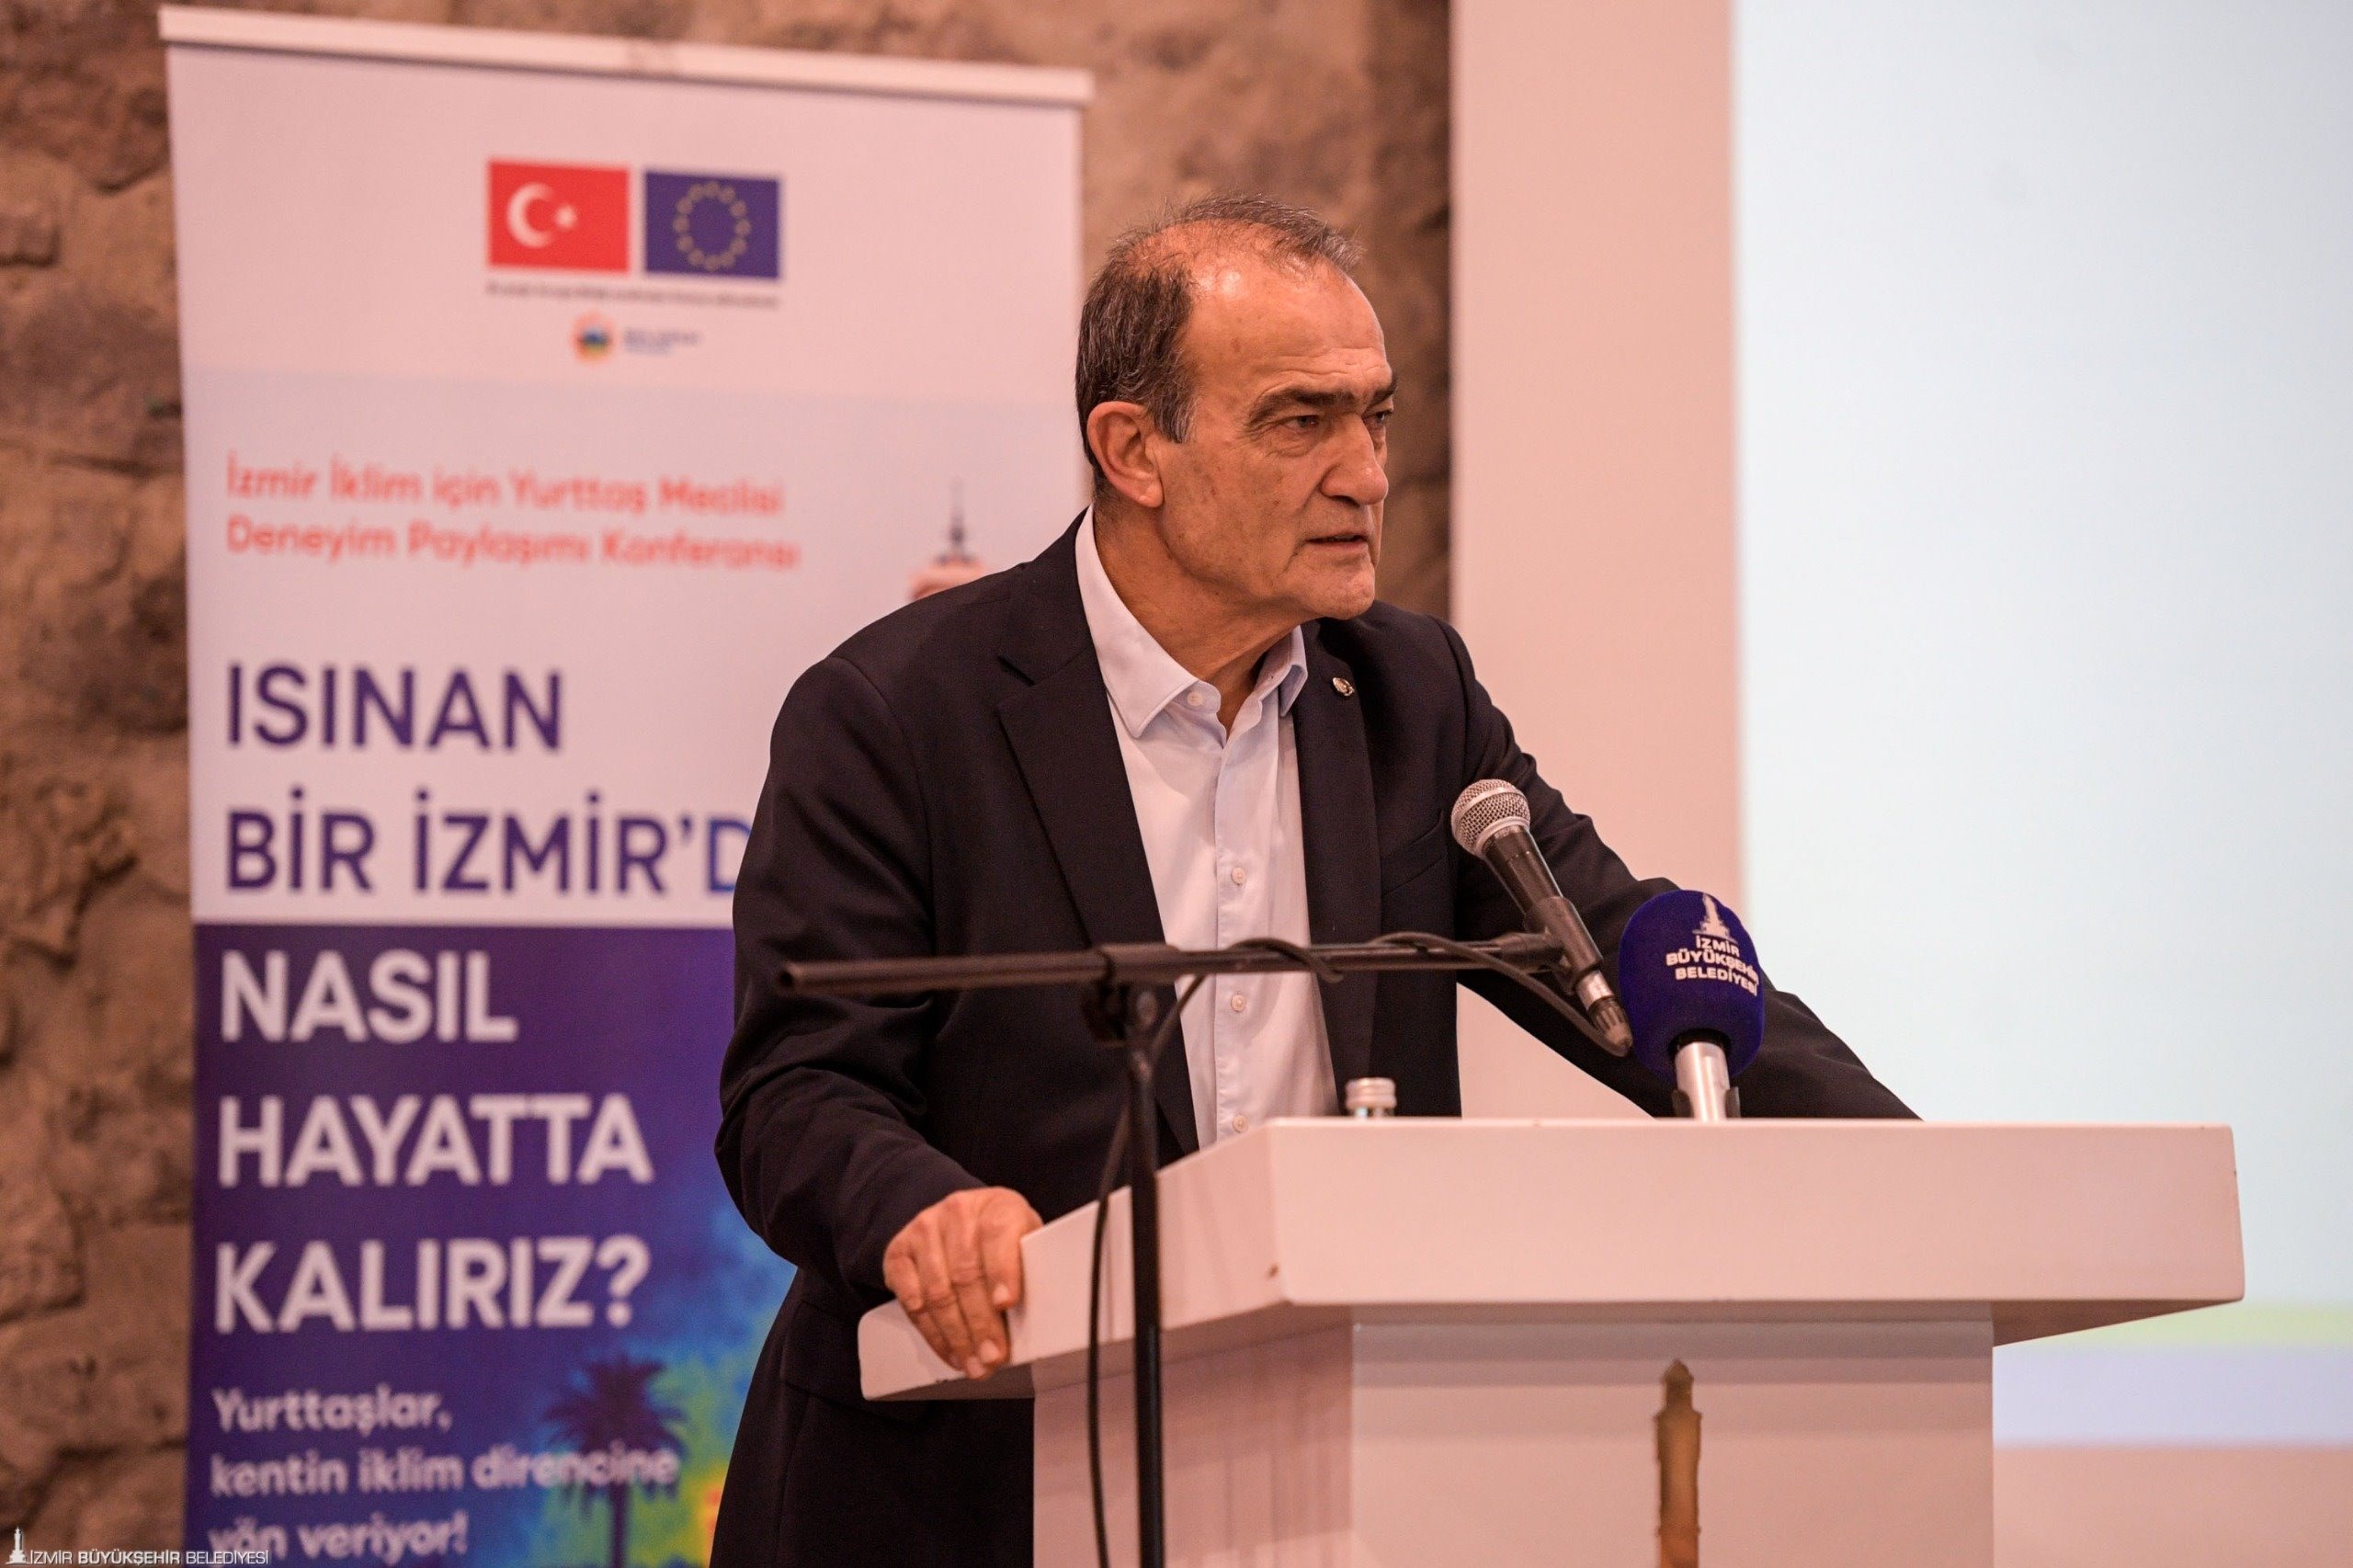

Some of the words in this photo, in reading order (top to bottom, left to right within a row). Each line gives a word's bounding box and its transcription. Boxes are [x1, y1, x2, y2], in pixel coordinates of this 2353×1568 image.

[226, 449, 316, 498] İzmir
[329, 452, 423, 502] İklim
[432, 463, 501, 511] için
[657, 474, 784, 517] Meclisi
[226, 513, 396, 564] Deneyim
[227, 663, 563, 751] ISINAN
[226, 786, 378, 892] BİR
[1696, 935, 1740, 958] İZMİR
[222, 949, 519, 1044] NASIL
[218, 1094, 654, 1187] HAYATTA
[215, 1235, 651, 1335] KALIRIZ?
[210, 1449, 349, 1497] kentin
[358, 1445, 465, 1493] iklim
[472, 1438, 678, 1491] direncine
[296, 1508, 469, 1565] veriyor!
